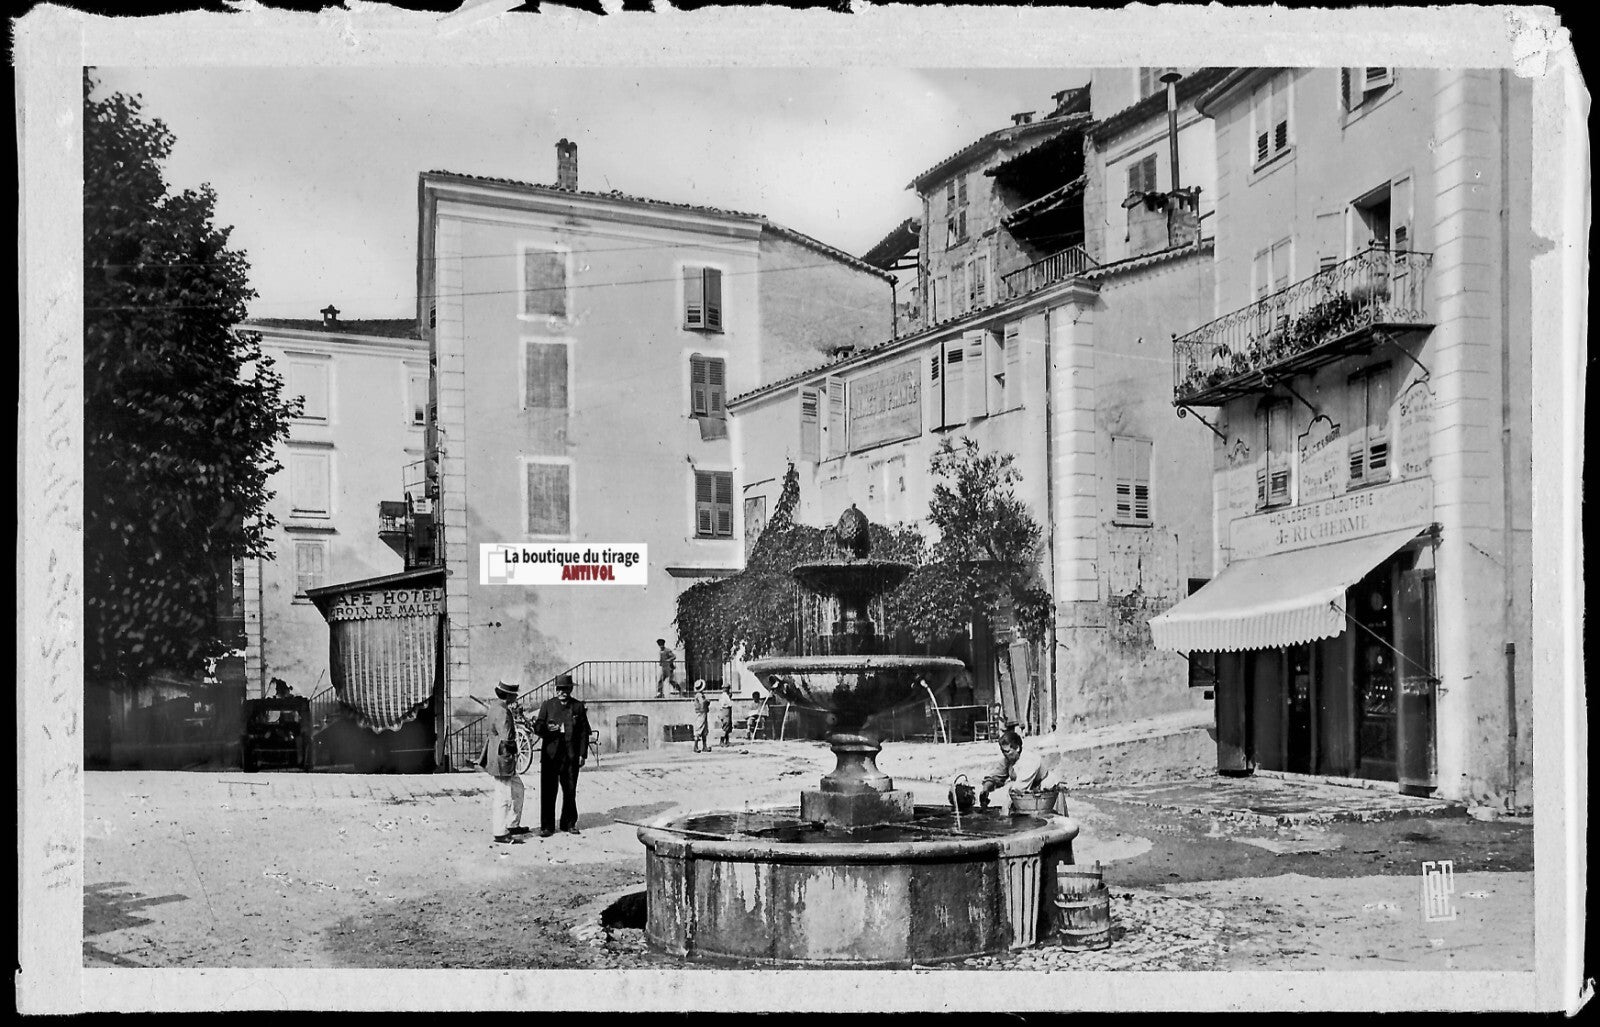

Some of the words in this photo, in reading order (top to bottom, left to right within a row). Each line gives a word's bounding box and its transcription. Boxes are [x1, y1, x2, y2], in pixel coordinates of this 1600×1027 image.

[1270, 504, 1320, 526] HORLOGERIE
[1325, 493, 1374, 516] BIJOUTERIE
[1293, 514, 1369, 543] RICHERME
[336, 592, 373, 606] AFE
[382, 589, 442, 605] HOTEL
[375, 606, 392, 615] DE
[398, 603, 439, 614] MALTE
